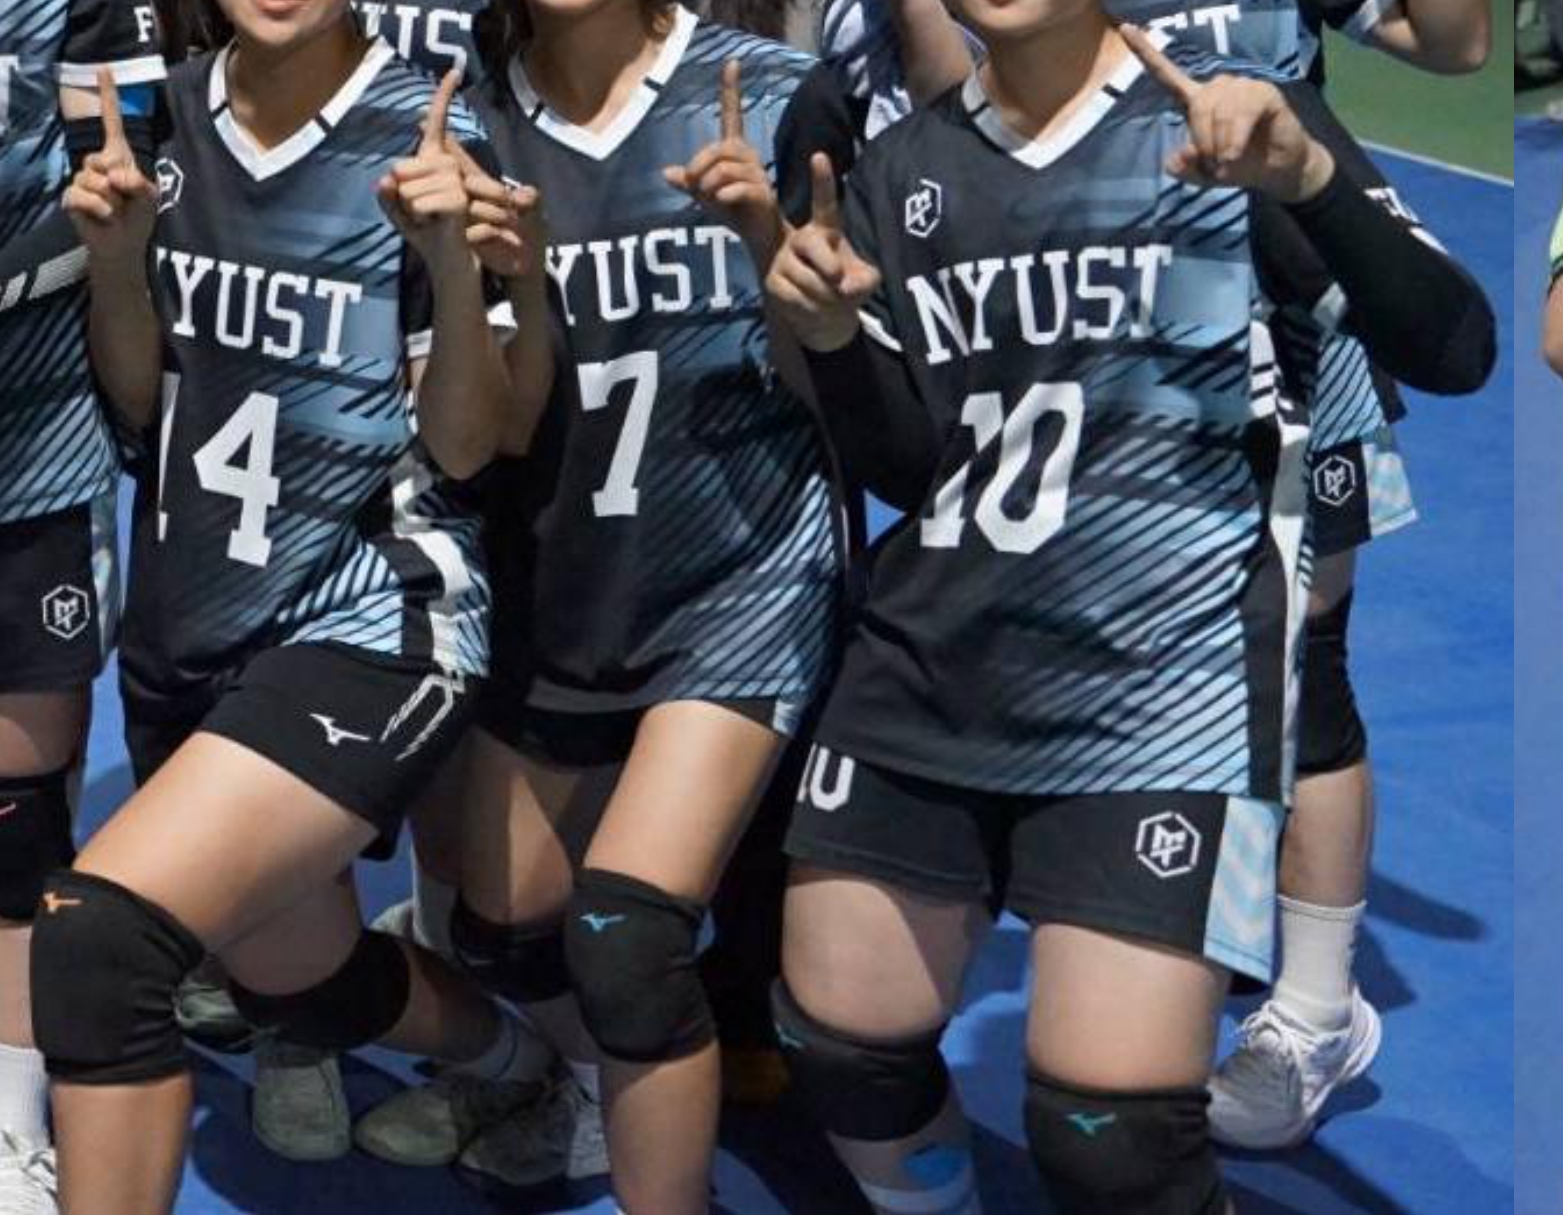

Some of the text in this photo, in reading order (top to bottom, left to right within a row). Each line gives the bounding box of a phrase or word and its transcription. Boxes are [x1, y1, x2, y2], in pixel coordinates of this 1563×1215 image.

[156, 245, 363, 368] YUST
[544, 225, 741, 326] YUST
[905, 245, 1172, 365] NYUST
[577, 349, 659, 518] 7
[920, 381, 1084, 555] 10
